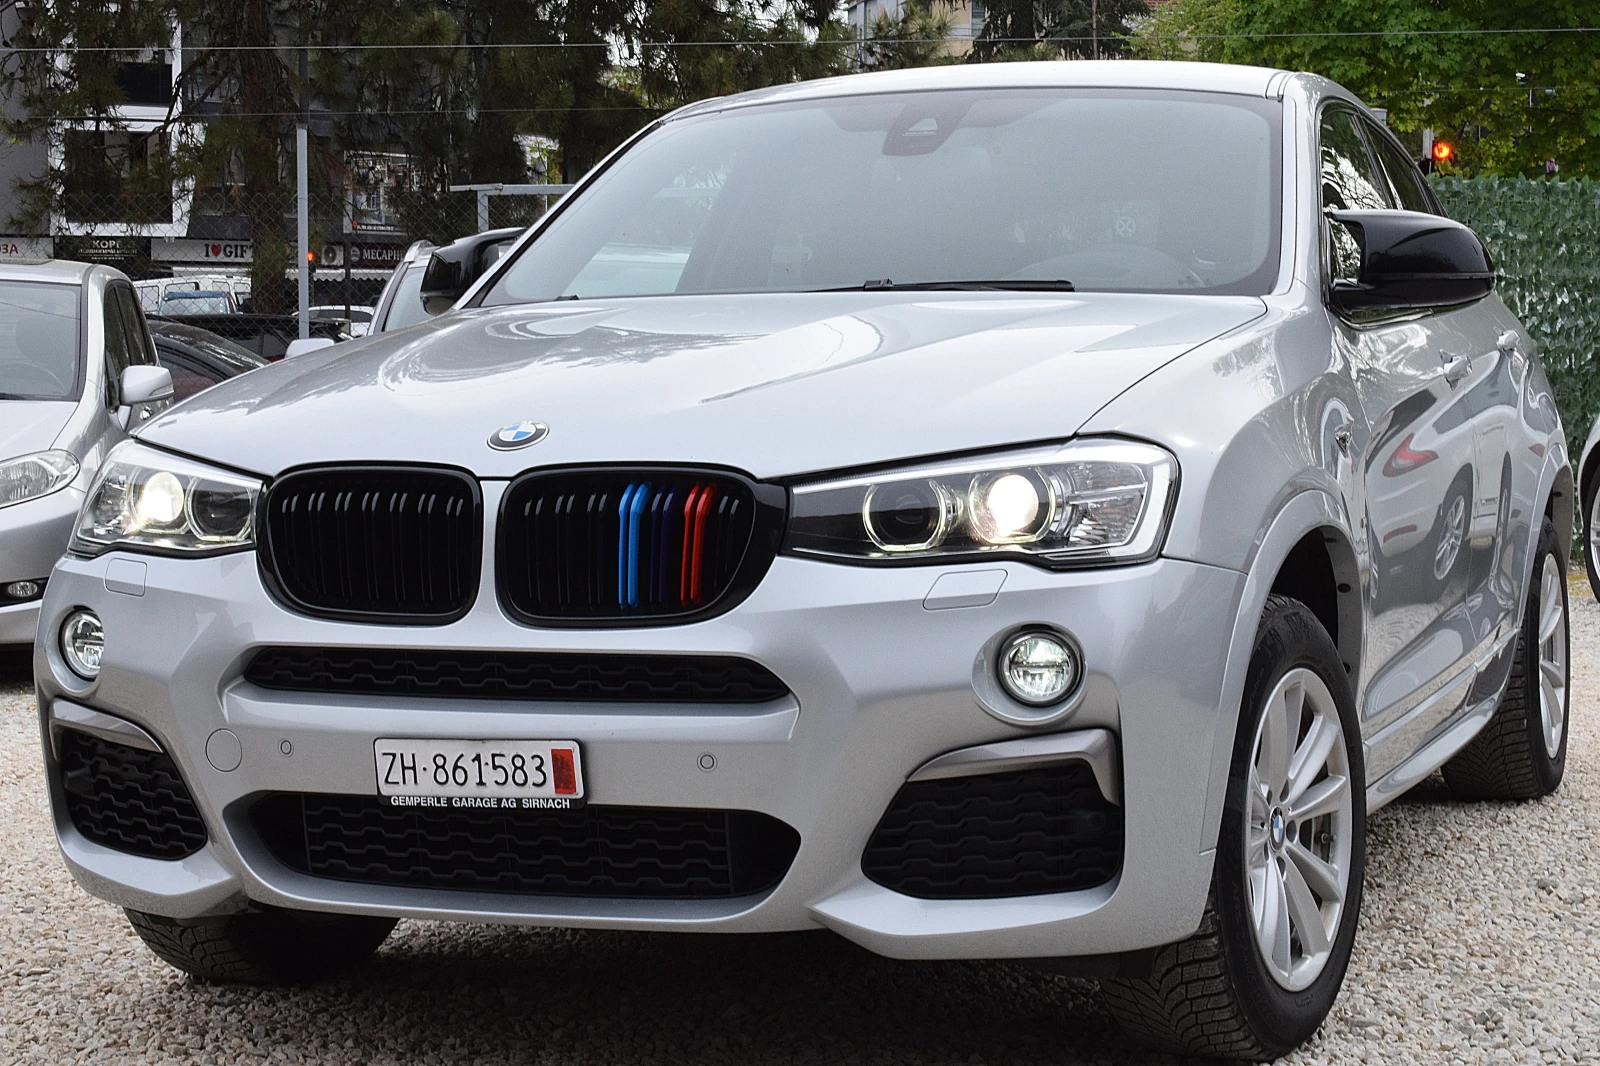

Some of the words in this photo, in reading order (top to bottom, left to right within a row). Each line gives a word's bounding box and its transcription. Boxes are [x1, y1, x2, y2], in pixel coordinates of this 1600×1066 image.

[0, 243, 18, 254] ЗА
[390, 795, 448, 807] GEMPERLE
[452, 797, 498, 808] GARAGE
[501, 798, 517, 808] AG
[522, 798, 570, 809] SIRNACH
